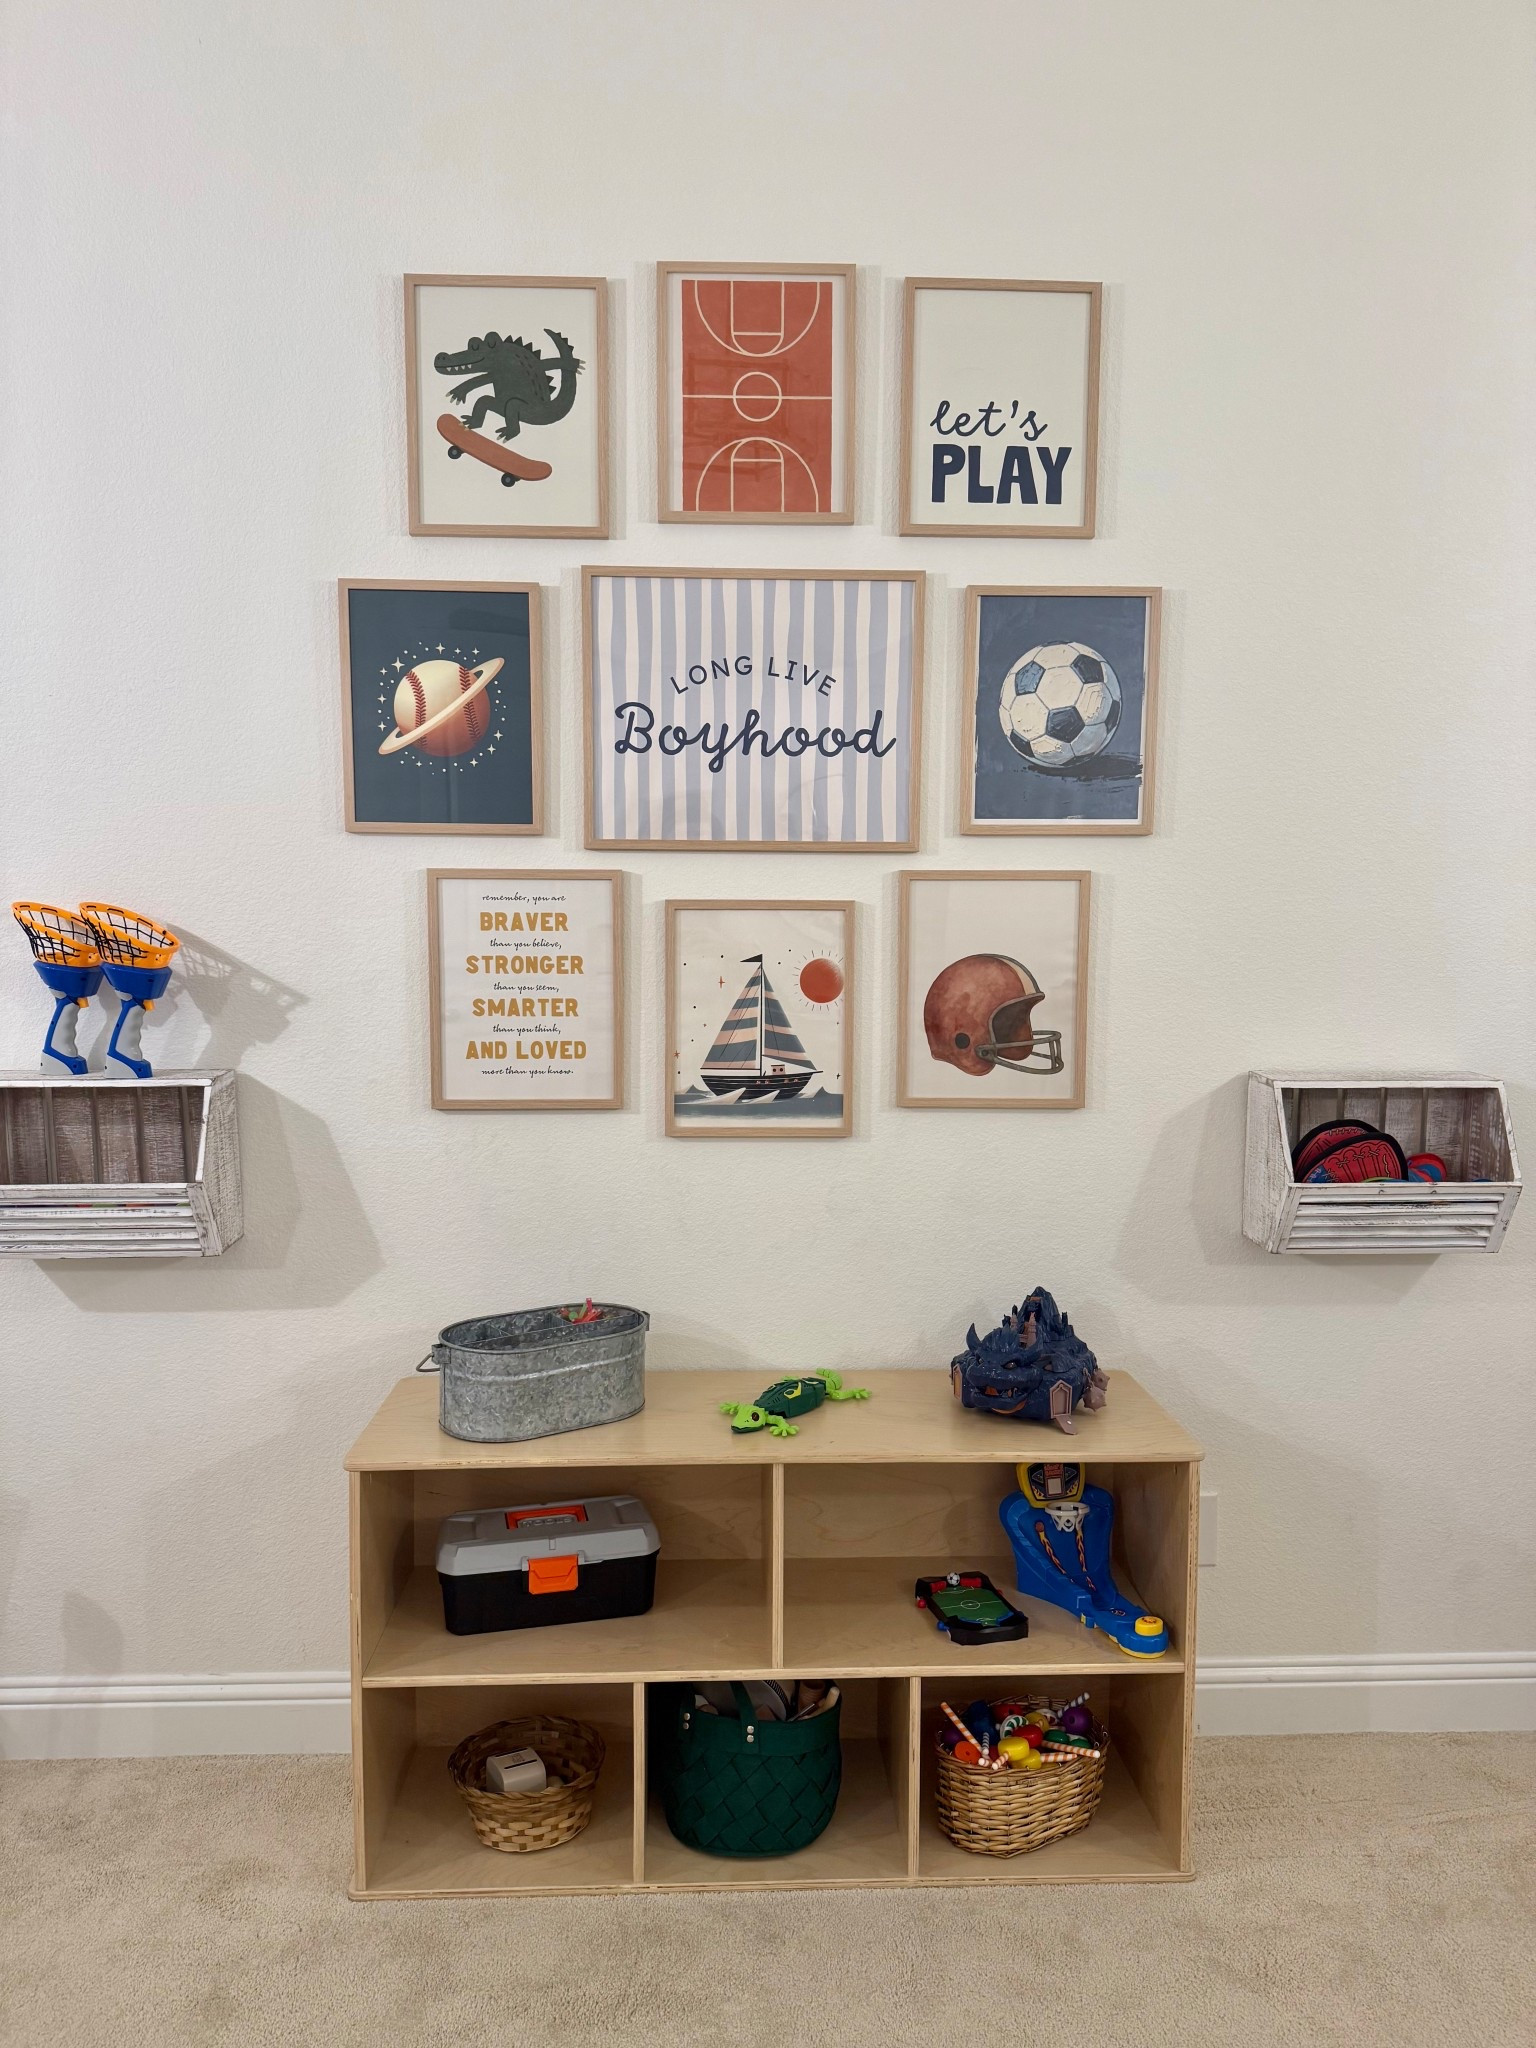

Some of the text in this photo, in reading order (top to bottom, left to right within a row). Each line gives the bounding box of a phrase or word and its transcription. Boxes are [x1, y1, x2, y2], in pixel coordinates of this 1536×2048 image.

[930, 400, 1048, 441] let's
[931, 443, 1073, 505] PLAY
[670, 655, 837, 697] LONG LIVE
[614, 701, 897, 773] Boyhood
[482, 892, 530, 903] remember,
[532, 895, 550, 905] you
[480, 912, 569, 931] BRAVER
[490, 938, 562, 951] than you believe,
[465, 955, 585, 974] STRONGER
[494, 982, 515, 990] than
[517, 985, 535, 994] you
[472, 998, 579, 1017] SMARTER
[493, 1024, 561, 1036] than you think,
[465, 1040, 587, 1060] AND LOVED
[505, 1066, 527, 1075] than
[529, 1069, 546, 1078] you
[547, 1066, 574, 1075] know.
[522, 1516, 573, 1528] TOOLS
